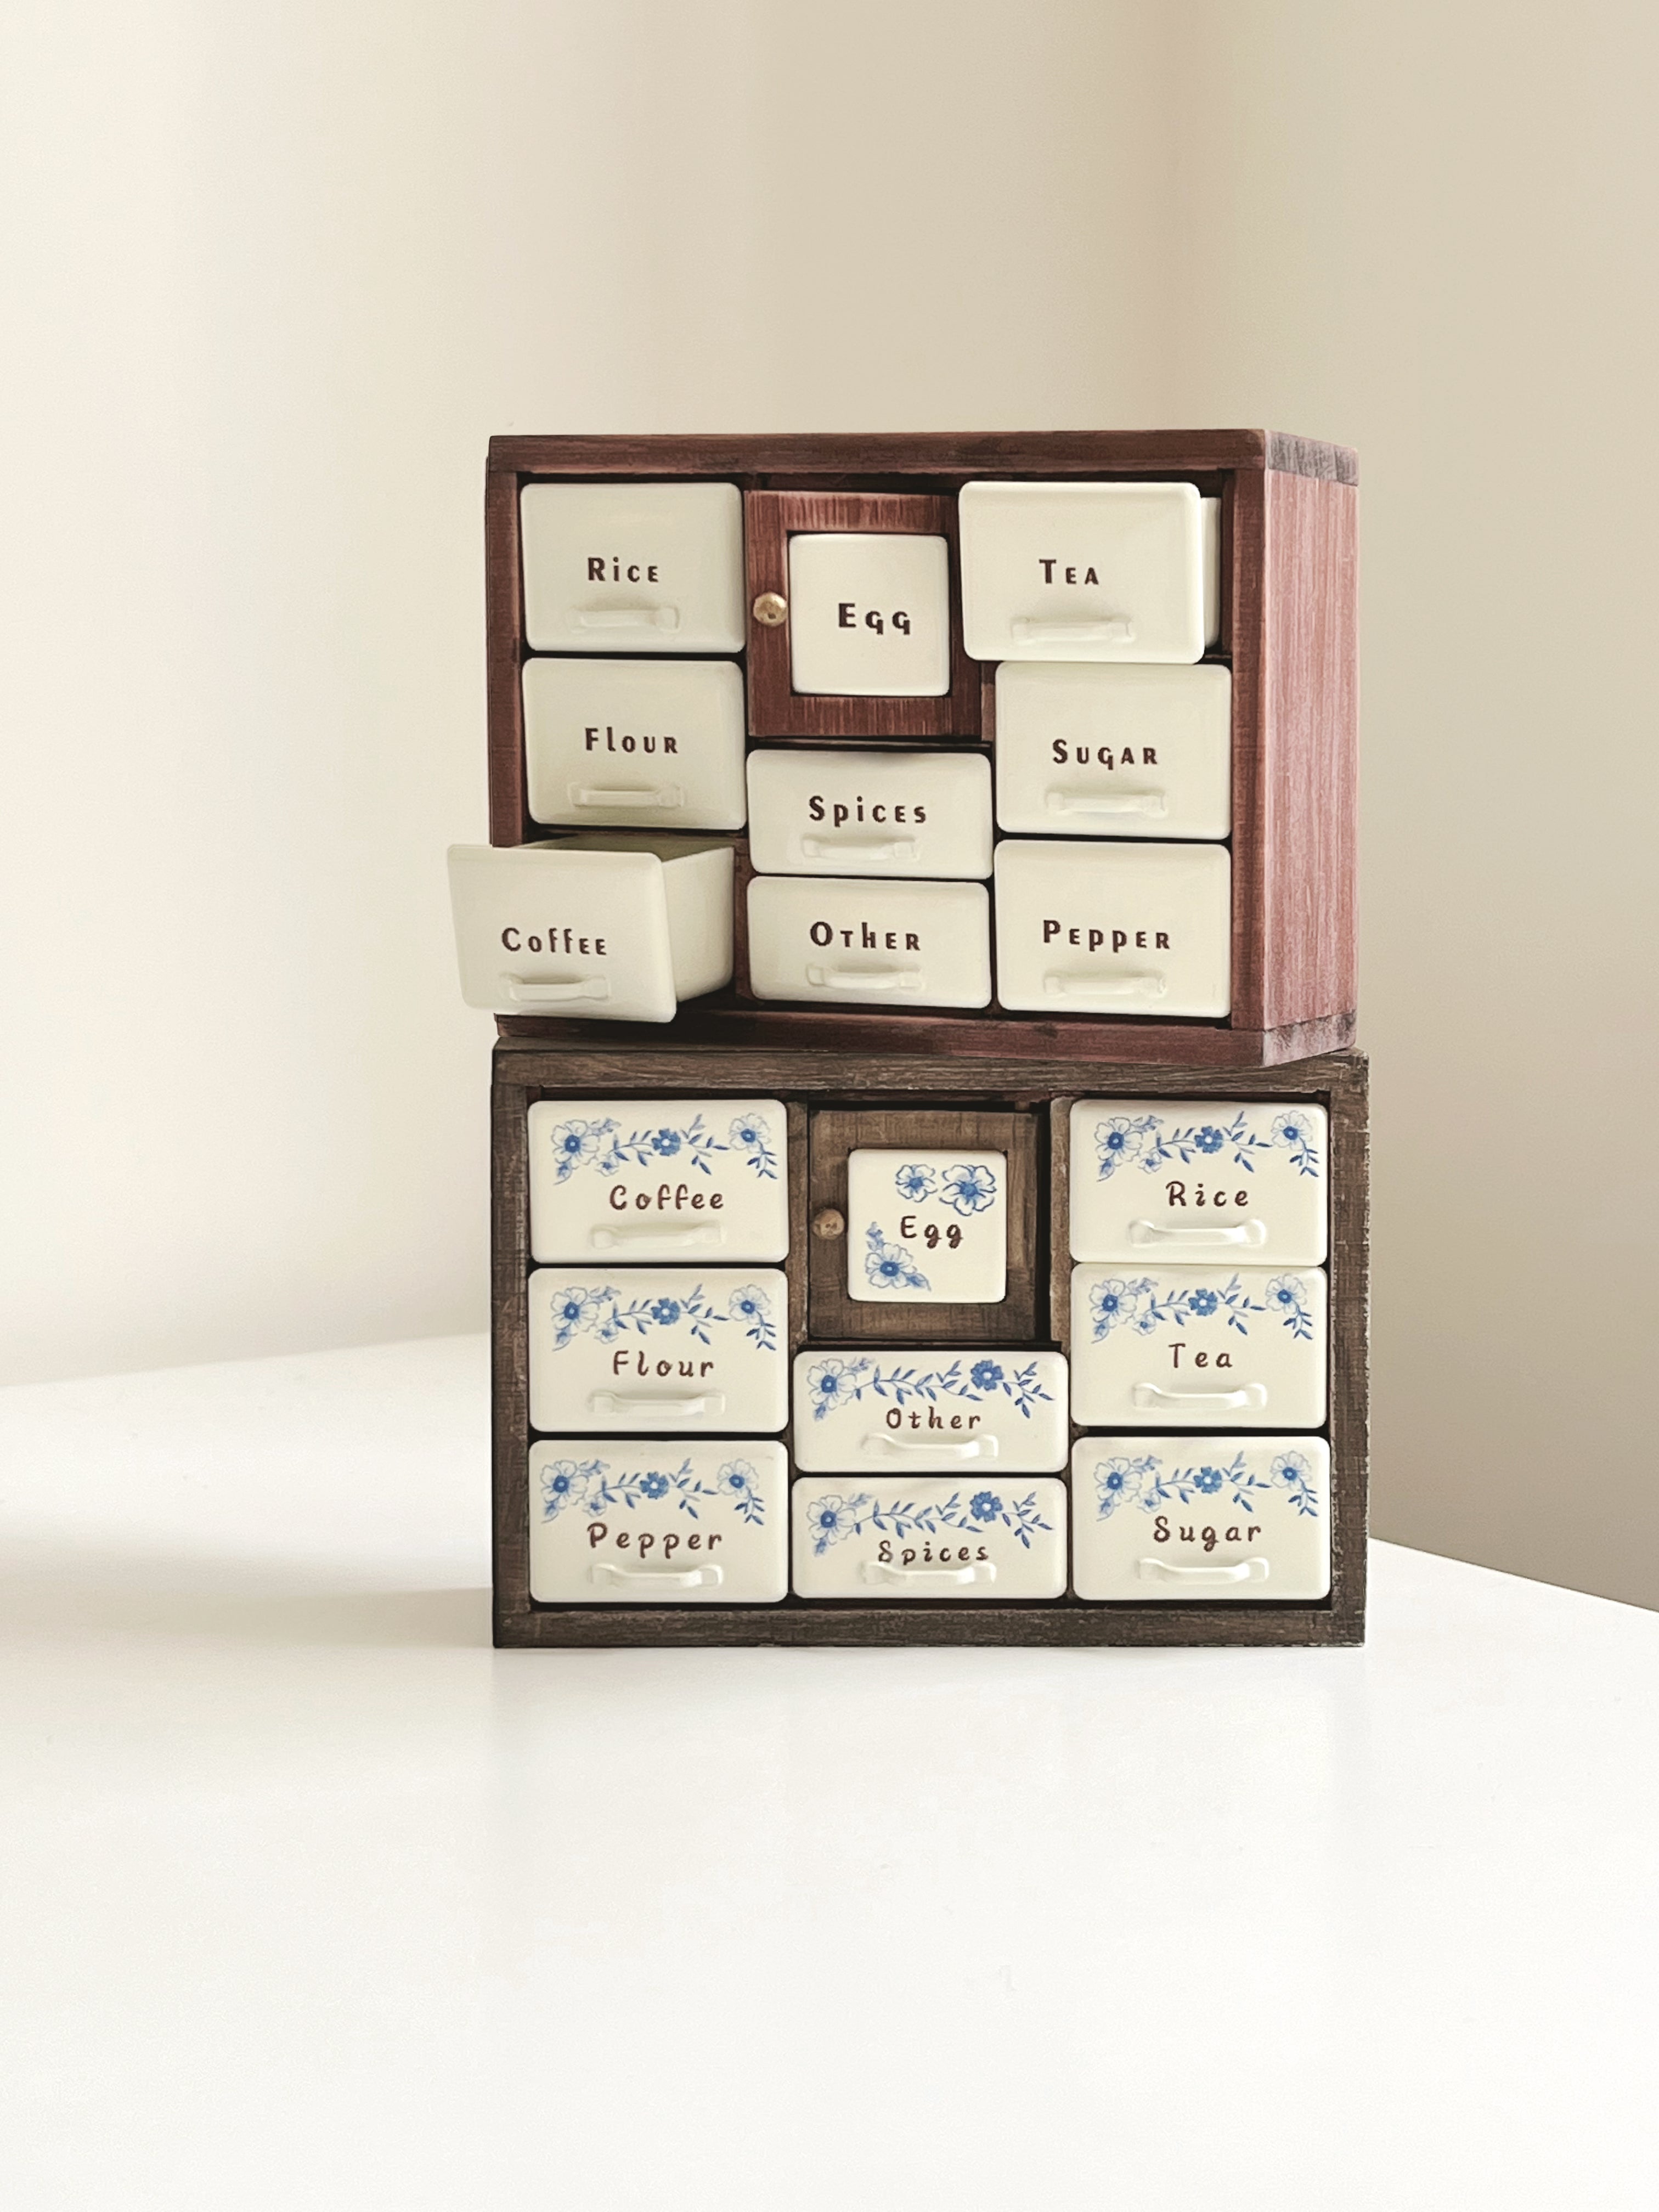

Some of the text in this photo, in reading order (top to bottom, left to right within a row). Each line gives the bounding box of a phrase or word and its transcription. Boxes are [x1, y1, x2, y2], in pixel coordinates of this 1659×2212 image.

[838, 602, 911, 636] Egg
[609, 1183, 724, 1211] Coffee
[1165, 1180, 1249, 1207] Rice
[900, 1215, 964, 1249] Egg
[613, 1350, 714, 1378] Flour
[1168, 1342, 1233, 1369] Tea
[885, 1406, 981, 1430] Other
[586, 1522, 723, 1559] Pepper
[1153, 1515, 1261, 1553] Sugar
[878, 1539, 989, 1566] Spices
